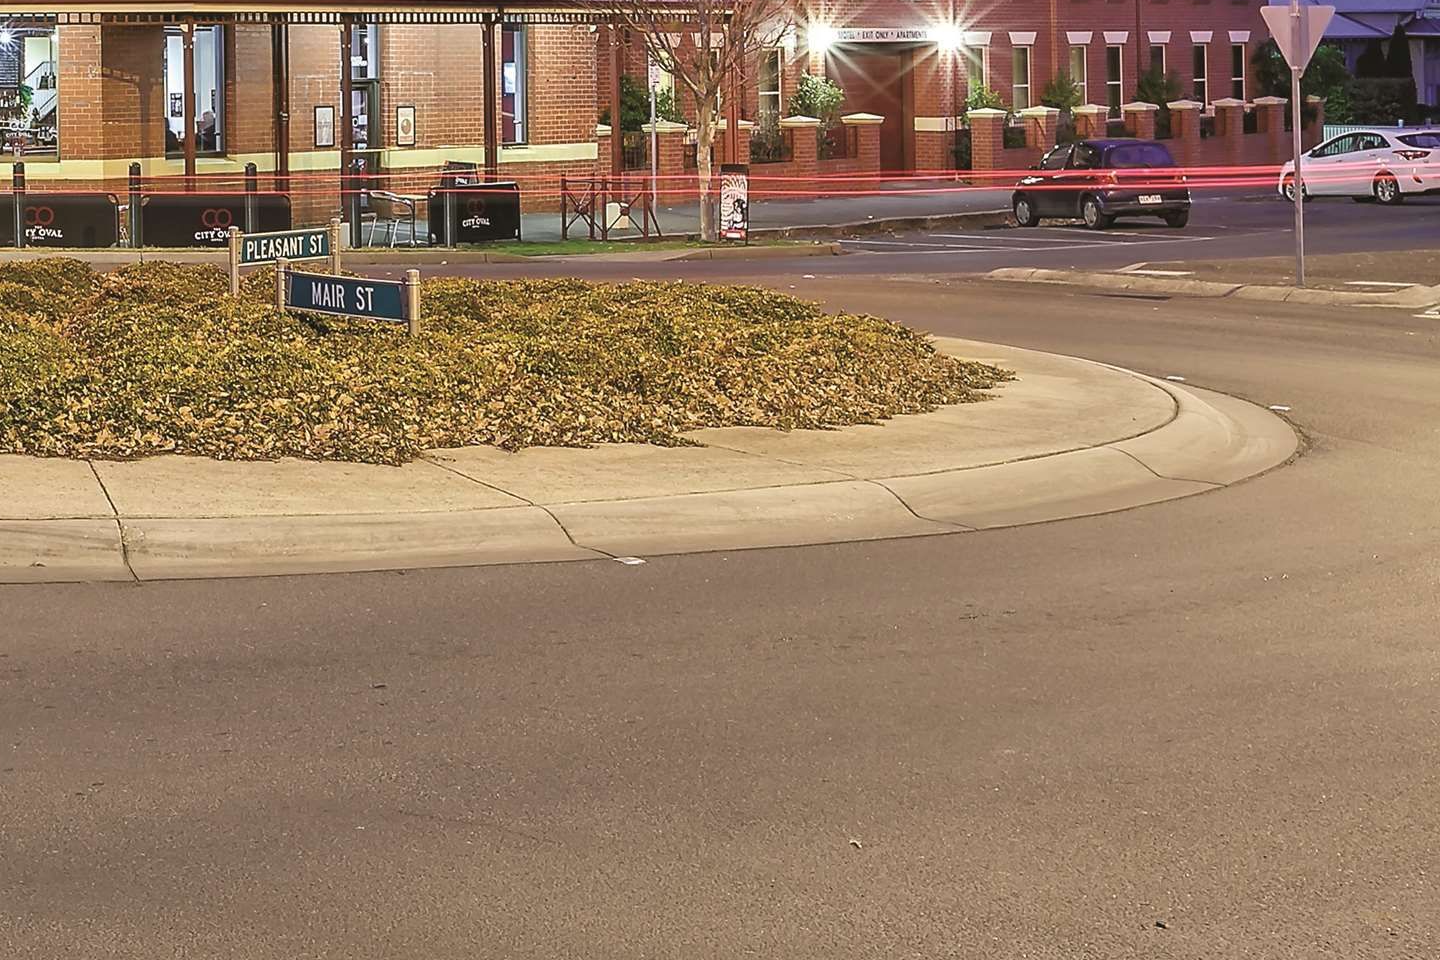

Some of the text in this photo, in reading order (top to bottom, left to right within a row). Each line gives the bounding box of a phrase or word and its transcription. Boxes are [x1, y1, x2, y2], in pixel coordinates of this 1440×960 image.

[875, 30, 889, 39] ONLY
[38, 228, 63, 238] OVAL
[194, 230, 215, 240] CITY
[246, 233, 324, 260] PLEASANT ST
[312, 281, 374, 312] MAIR ST
